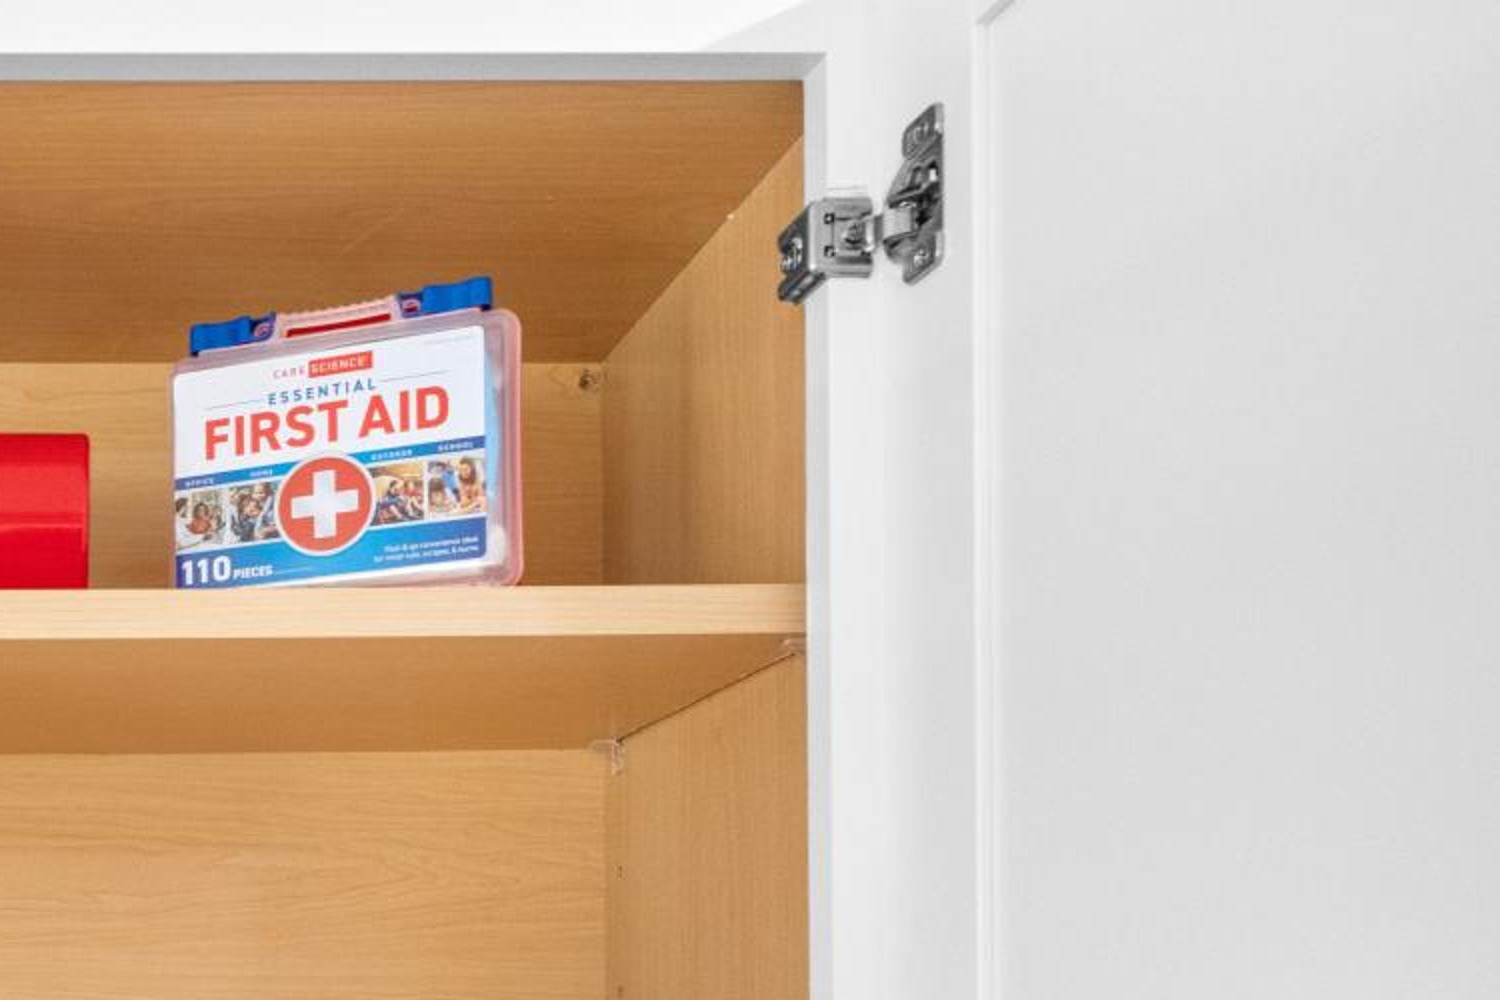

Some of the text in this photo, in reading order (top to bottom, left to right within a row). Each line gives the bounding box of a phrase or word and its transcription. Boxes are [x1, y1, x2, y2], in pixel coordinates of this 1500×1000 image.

[273, 355, 364, 378] CARE SCIENCE
[268, 379, 375, 405] ESSENTIAL
[206, 386, 449, 459] FIRST AID
[181, 556, 273, 585] 110 PIECES
